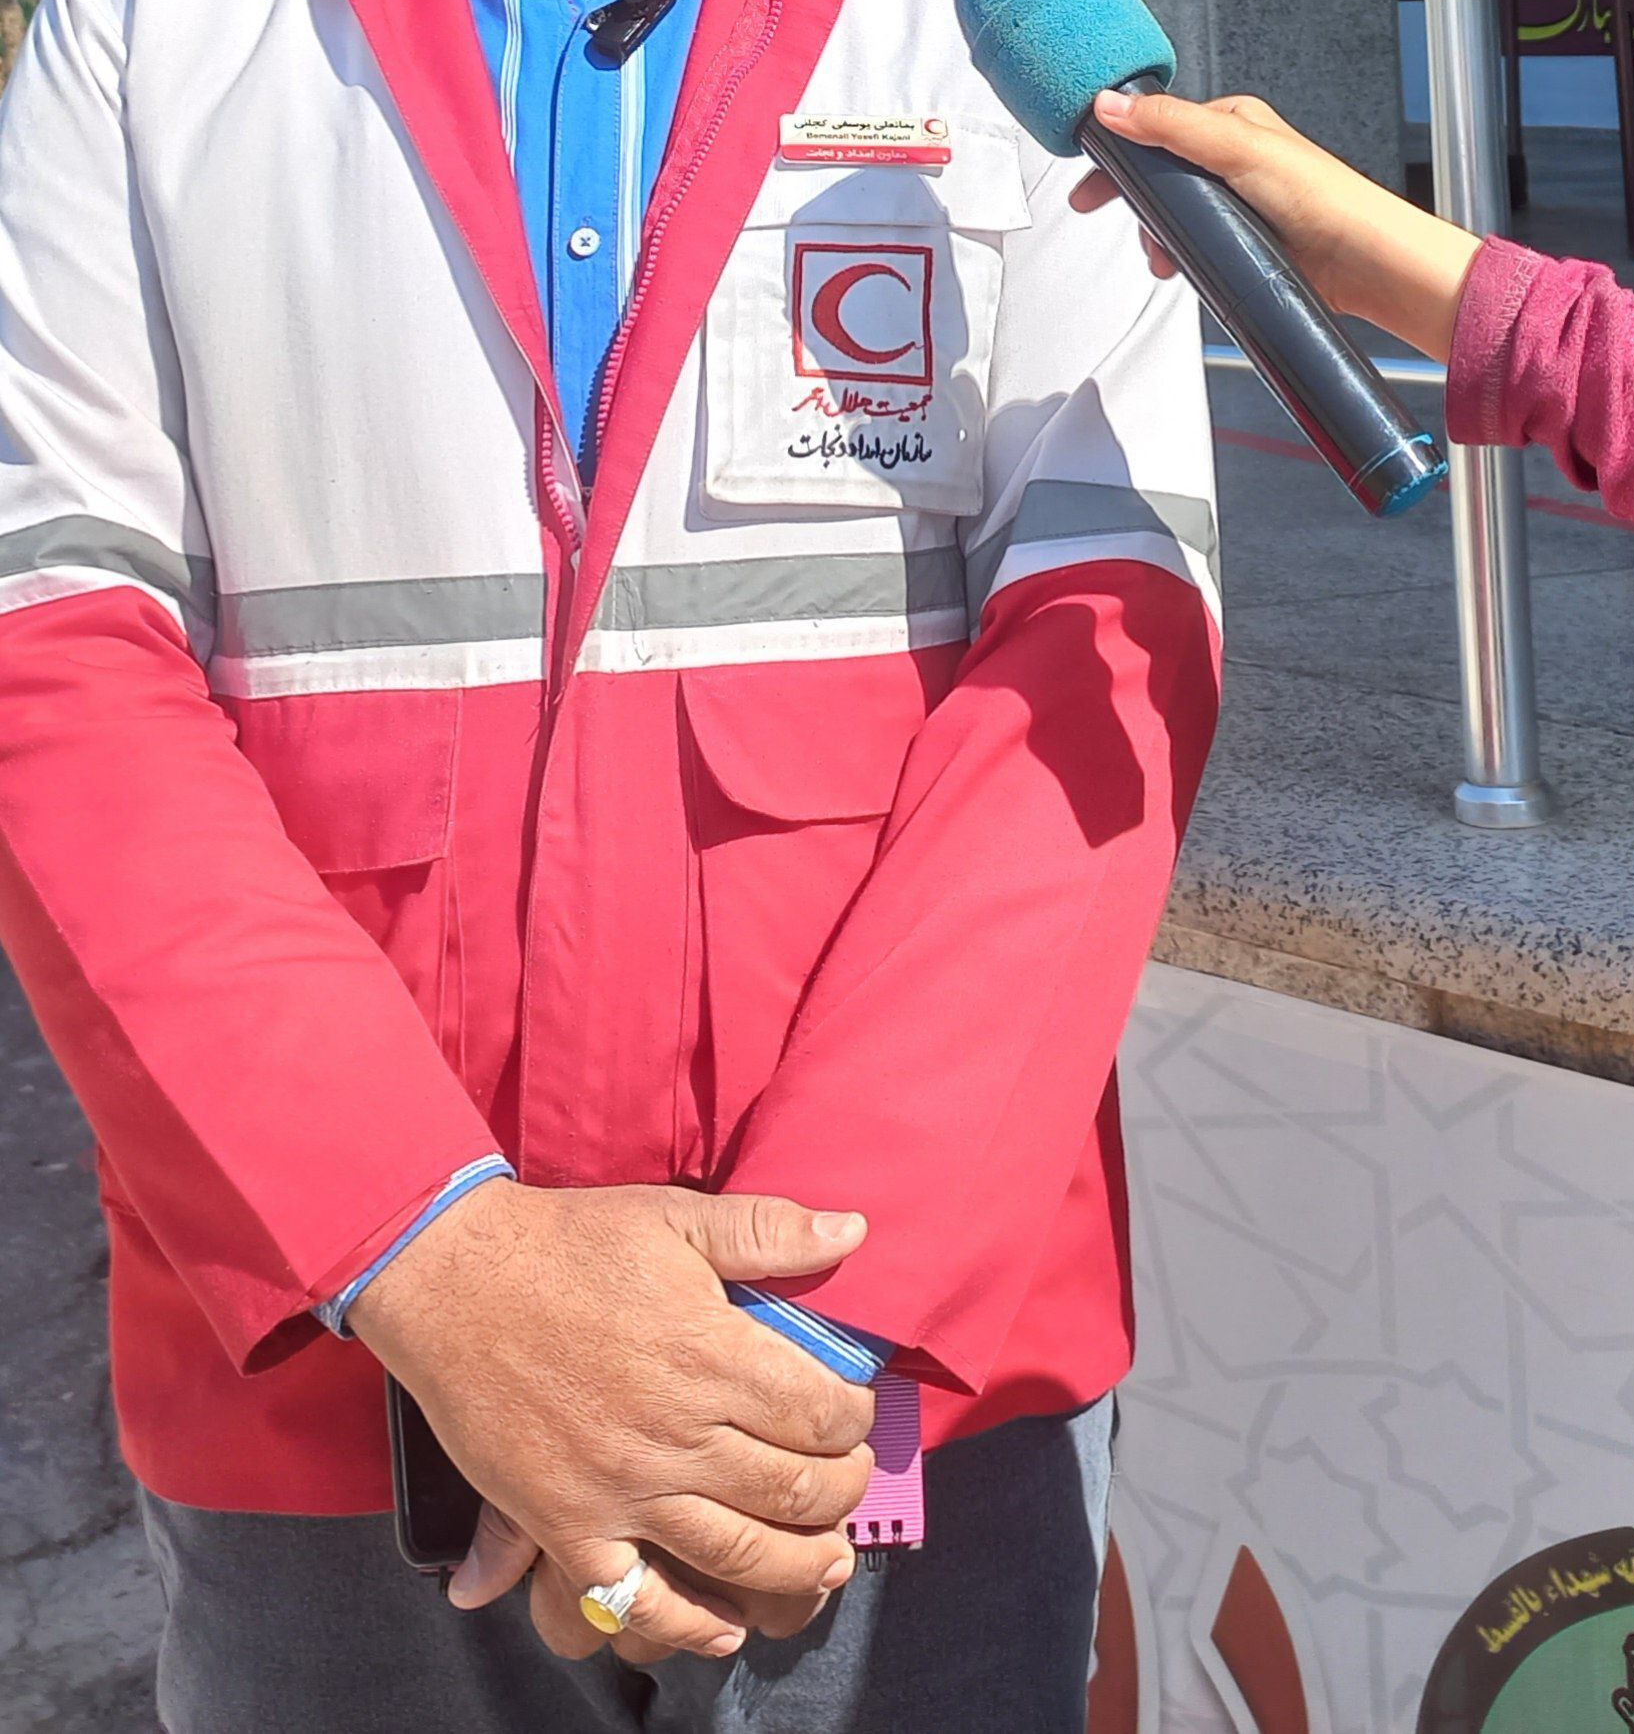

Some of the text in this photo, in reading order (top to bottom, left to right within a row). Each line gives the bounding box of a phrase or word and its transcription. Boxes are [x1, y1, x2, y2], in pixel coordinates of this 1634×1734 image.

[832, 120, 871, 132] یوسفی
[806, 148, 835, 160] نجات
[846, 148, 875, 159] امداد
[879, 432, 933, 469] سازمان
